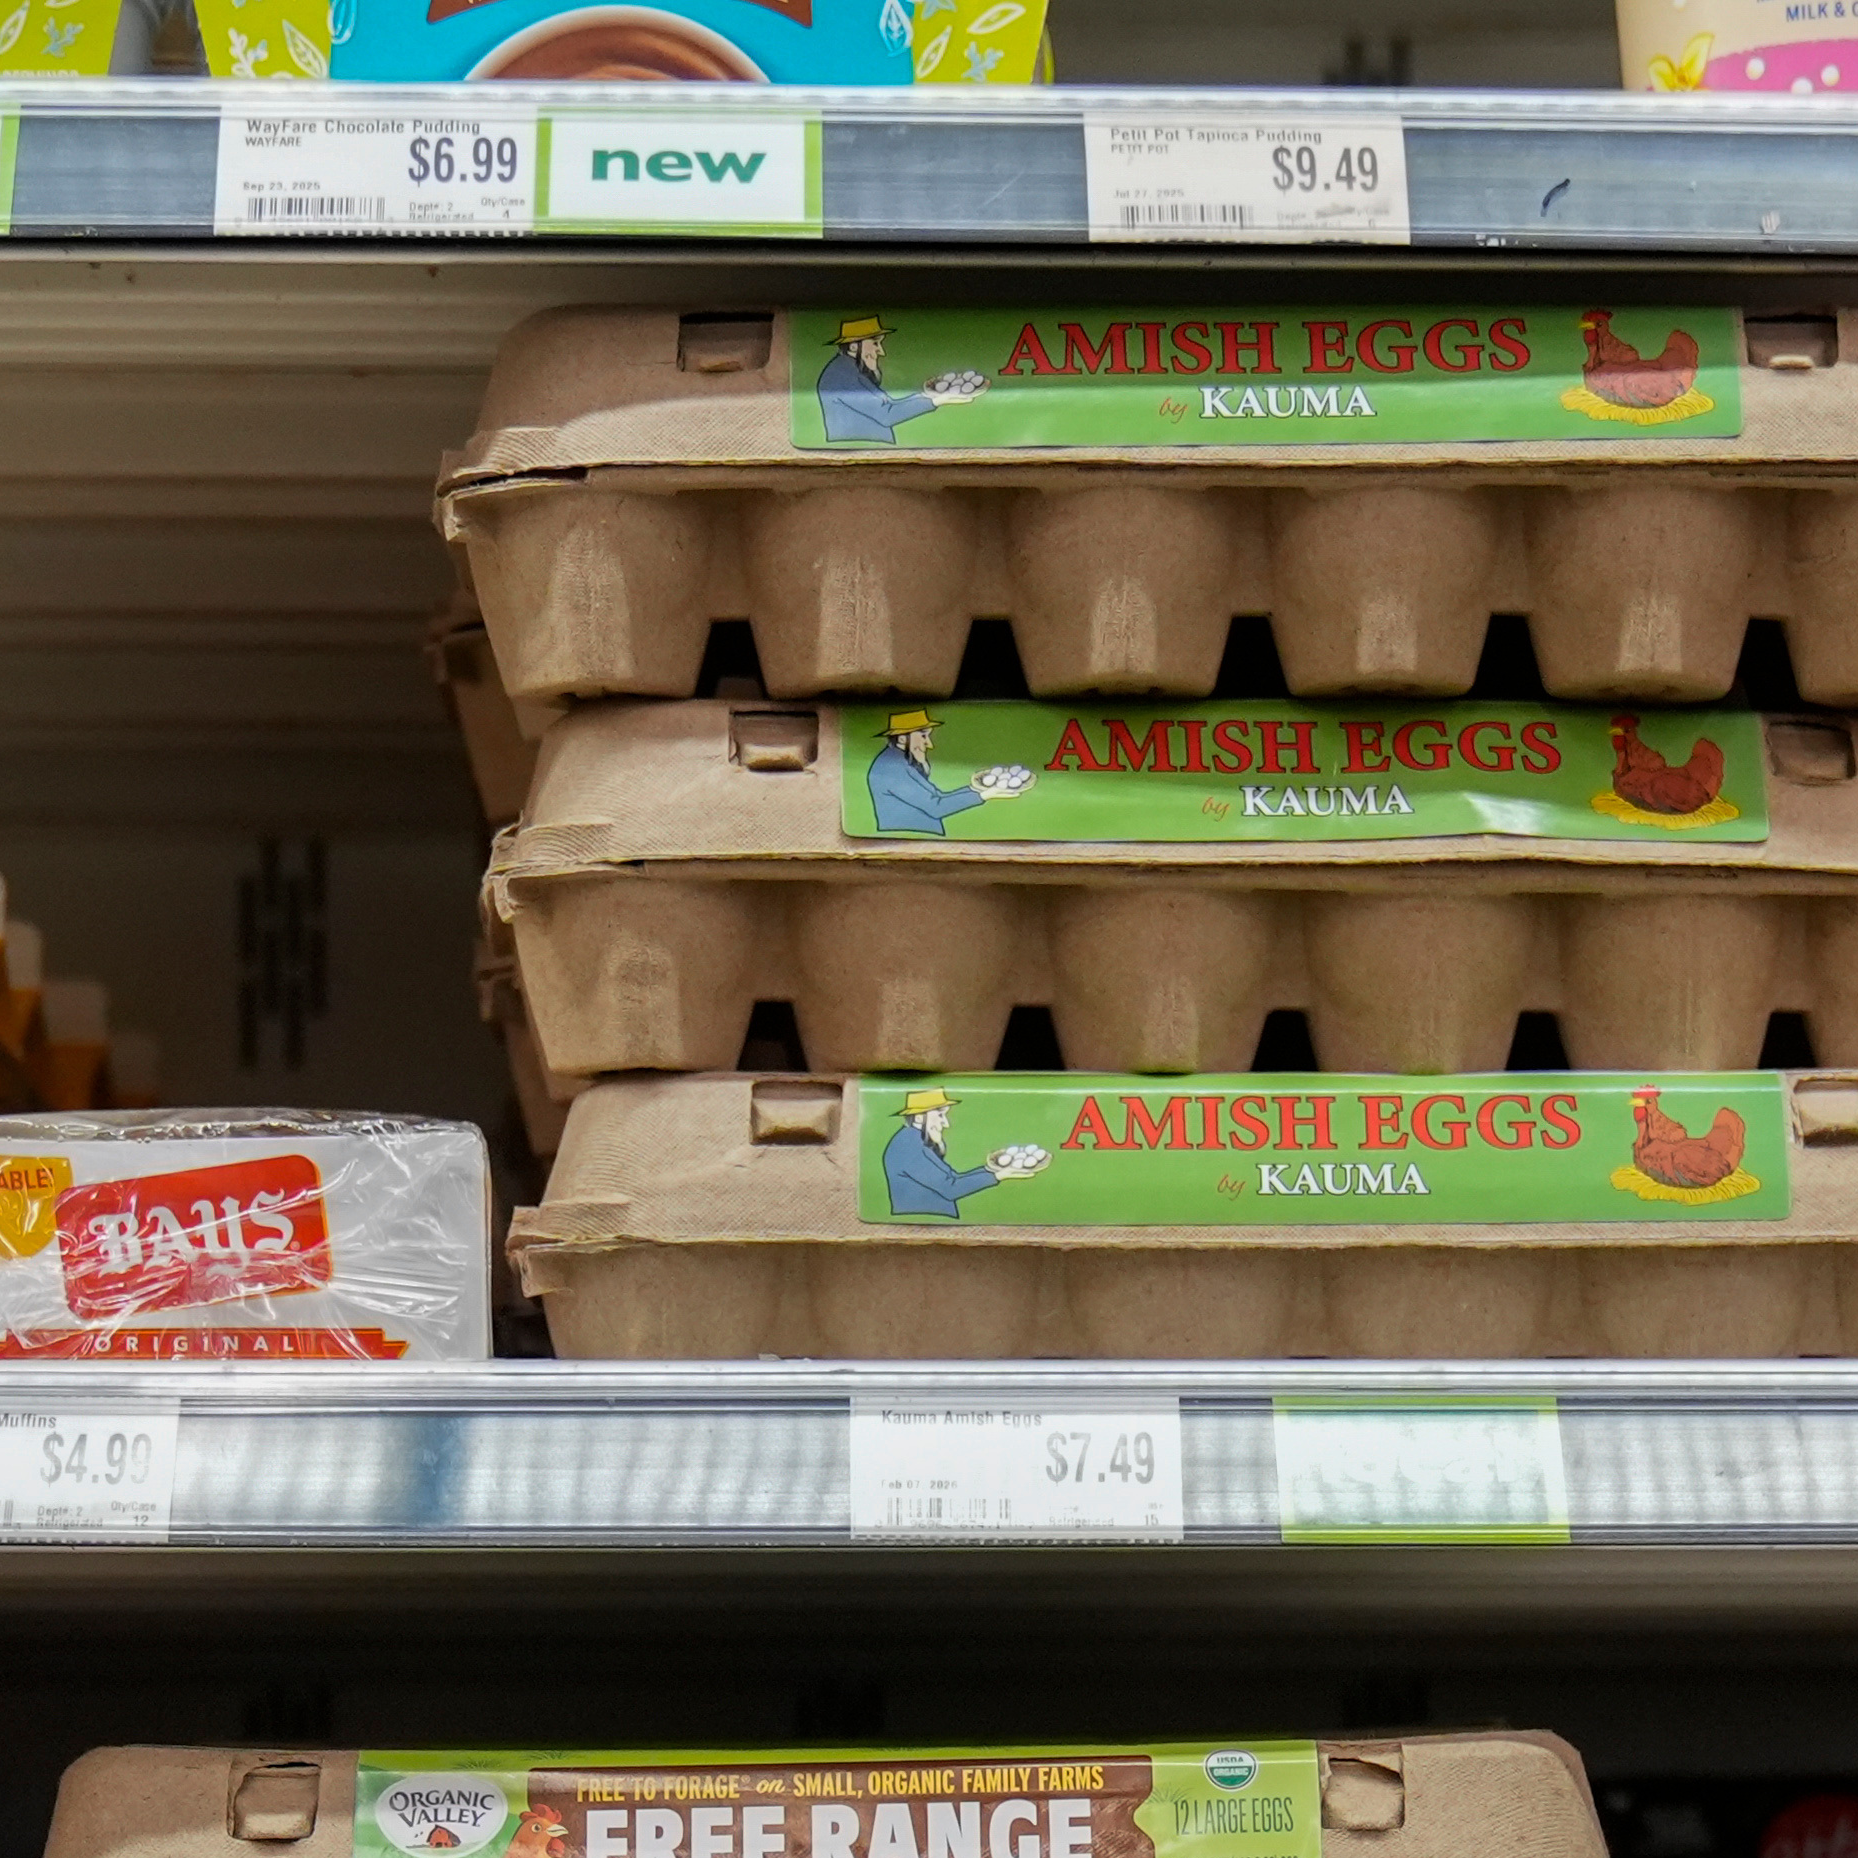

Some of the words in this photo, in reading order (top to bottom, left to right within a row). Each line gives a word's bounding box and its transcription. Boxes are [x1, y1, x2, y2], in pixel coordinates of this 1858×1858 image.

[1785, 4, 1828, 22] MILK
[246, 119, 317, 135] WayFare
[324, 119, 405, 134] Chocolate
[413, 120, 480, 136] Pudding
[1111, 128, 1147, 142] Petit
[1155, 128, 1180, 142] Pot
[1188, 128, 1248, 144] Tapioca
[1256, 129, 1322, 145] Pudding
[408, 136, 518, 188] $6.99
[591, 149, 767, 183] new
[1272, 145, 1379, 193] $9.49
[999, 319, 1284, 376] AMISH
[1304, 316, 1530, 375] EGGS
[1199, 385, 1377, 420] KAUMA
[1044, 718, 1321, 774] AMISH
[1340, 720, 1563, 774] EGGS
[1241, 784, 1413, 818] KAUMA
[1059, 1096, 1339, 1151] AMISH
[1358, 1092, 1582, 1150] EGGS
[1255, 1162, 1431, 1196] KAUMA
[95, 1333, 295, 1354] ORIGINAL
[881, 1410, 937, 1425] Kauma
[943, 1410, 994, 1425] Amish
[1002, 1410, 1042, 1427] Eggs
[41, 1432, 153, 1488] $4.99
[1045, 1430, 1155, 1487] $7.49
[1173, 1800, 1195, 1835] 12
[1197, 1799, 1248, 1833] LARGE
[1252, 1795, 1294, 1833] EGGS
